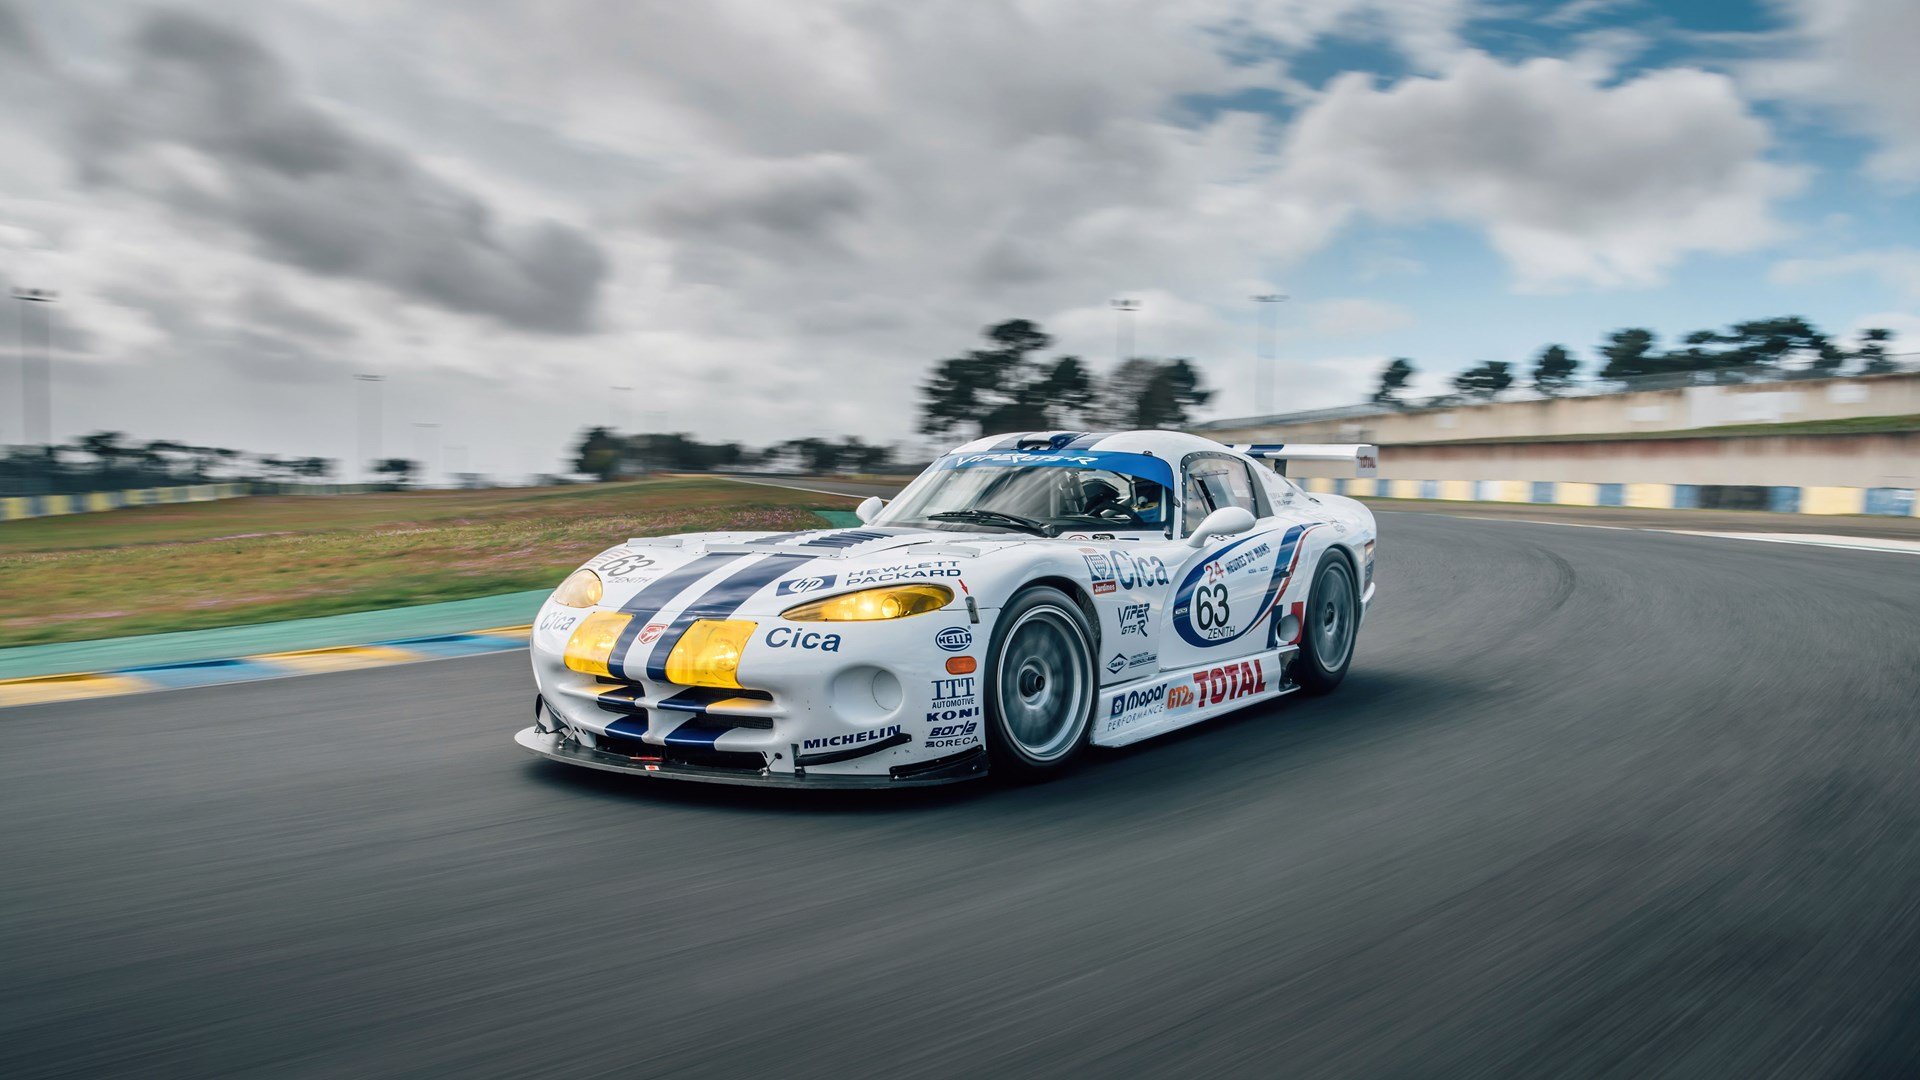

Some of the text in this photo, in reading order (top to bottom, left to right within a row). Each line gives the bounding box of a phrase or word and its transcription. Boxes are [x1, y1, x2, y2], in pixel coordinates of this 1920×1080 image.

[1359, 455, 1377, 468] TOTAL
[598, 555, 655, 577] 63
[848, 560, 961, 578] HEWLETT
[1109, 549, 1170, 590] Cica
[1205, 561, 1225, 585] 24
[794, 577, 820, 593] hp
[846, 569, 962, 586] PACKARD
[1117, 602, 1150, 628] VIPER
[1196, 583, 1230, 631] 63
[540, 611, 577, 631] Cica
[1121, 624, 1137, 635] GTS
[765, 626, 842, 653] Cica
[938, 631, 973, 645] HELLA
[1207, 626, 1236, 640] ZENITH
[931, 677, 975, 701] ITT
[1193, 659, 1267, 708] TOTAL
[931, 697, 975, 709] AUTOMOTIVE
[926, 706, 980, 722] KONI
[1106, 702, 1165, 732] PERFORMANCE
[803, 724, 901, 750] MICHELIN
[929, 720, 978, 737] Borla
